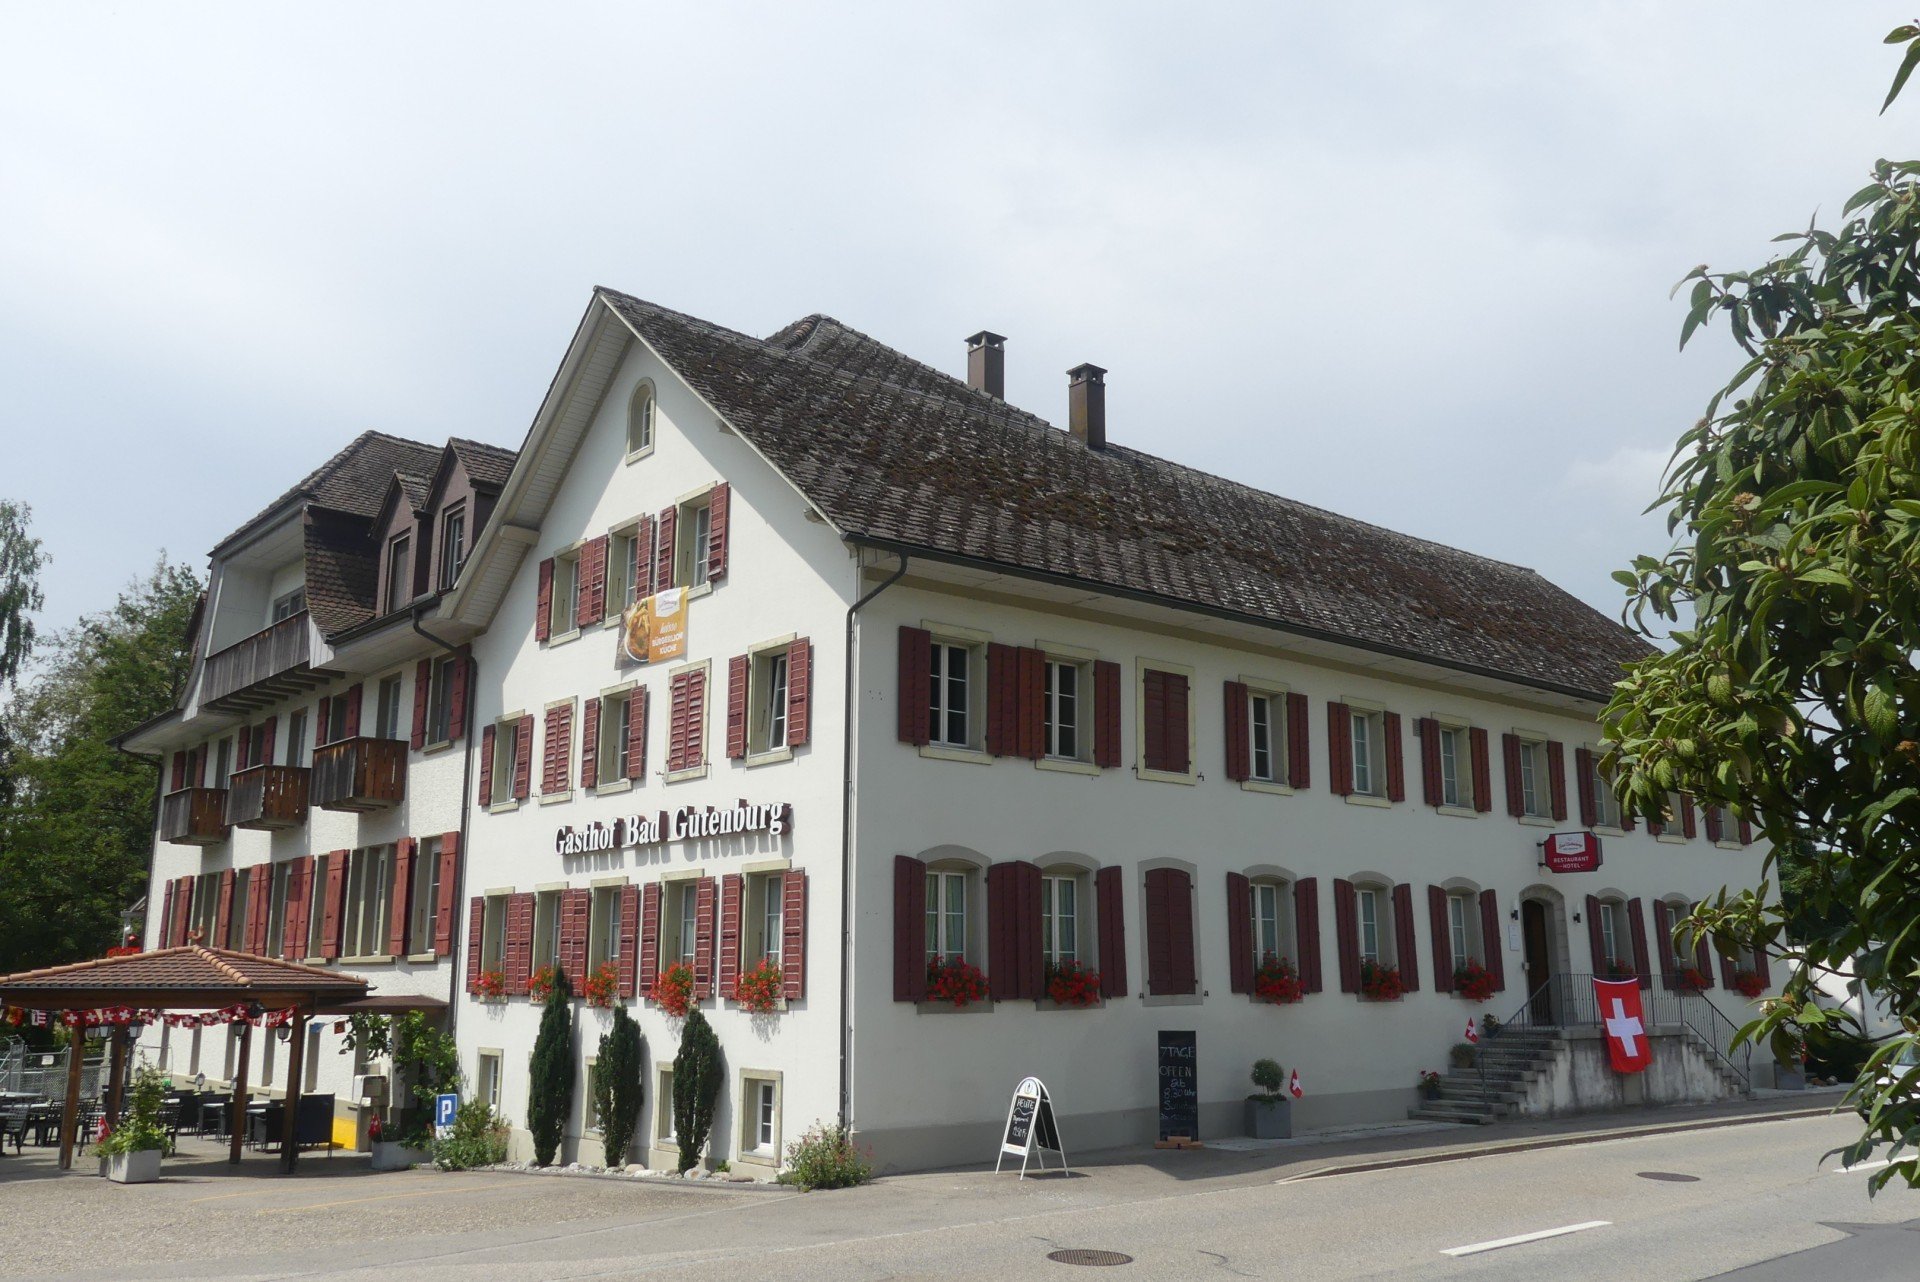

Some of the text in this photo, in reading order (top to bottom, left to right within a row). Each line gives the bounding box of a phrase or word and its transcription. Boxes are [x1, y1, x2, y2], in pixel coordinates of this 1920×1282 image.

[554, 798, 784, 855] Gasthof Bad Gutenburg
[442, 1100, 452, 1122] P
